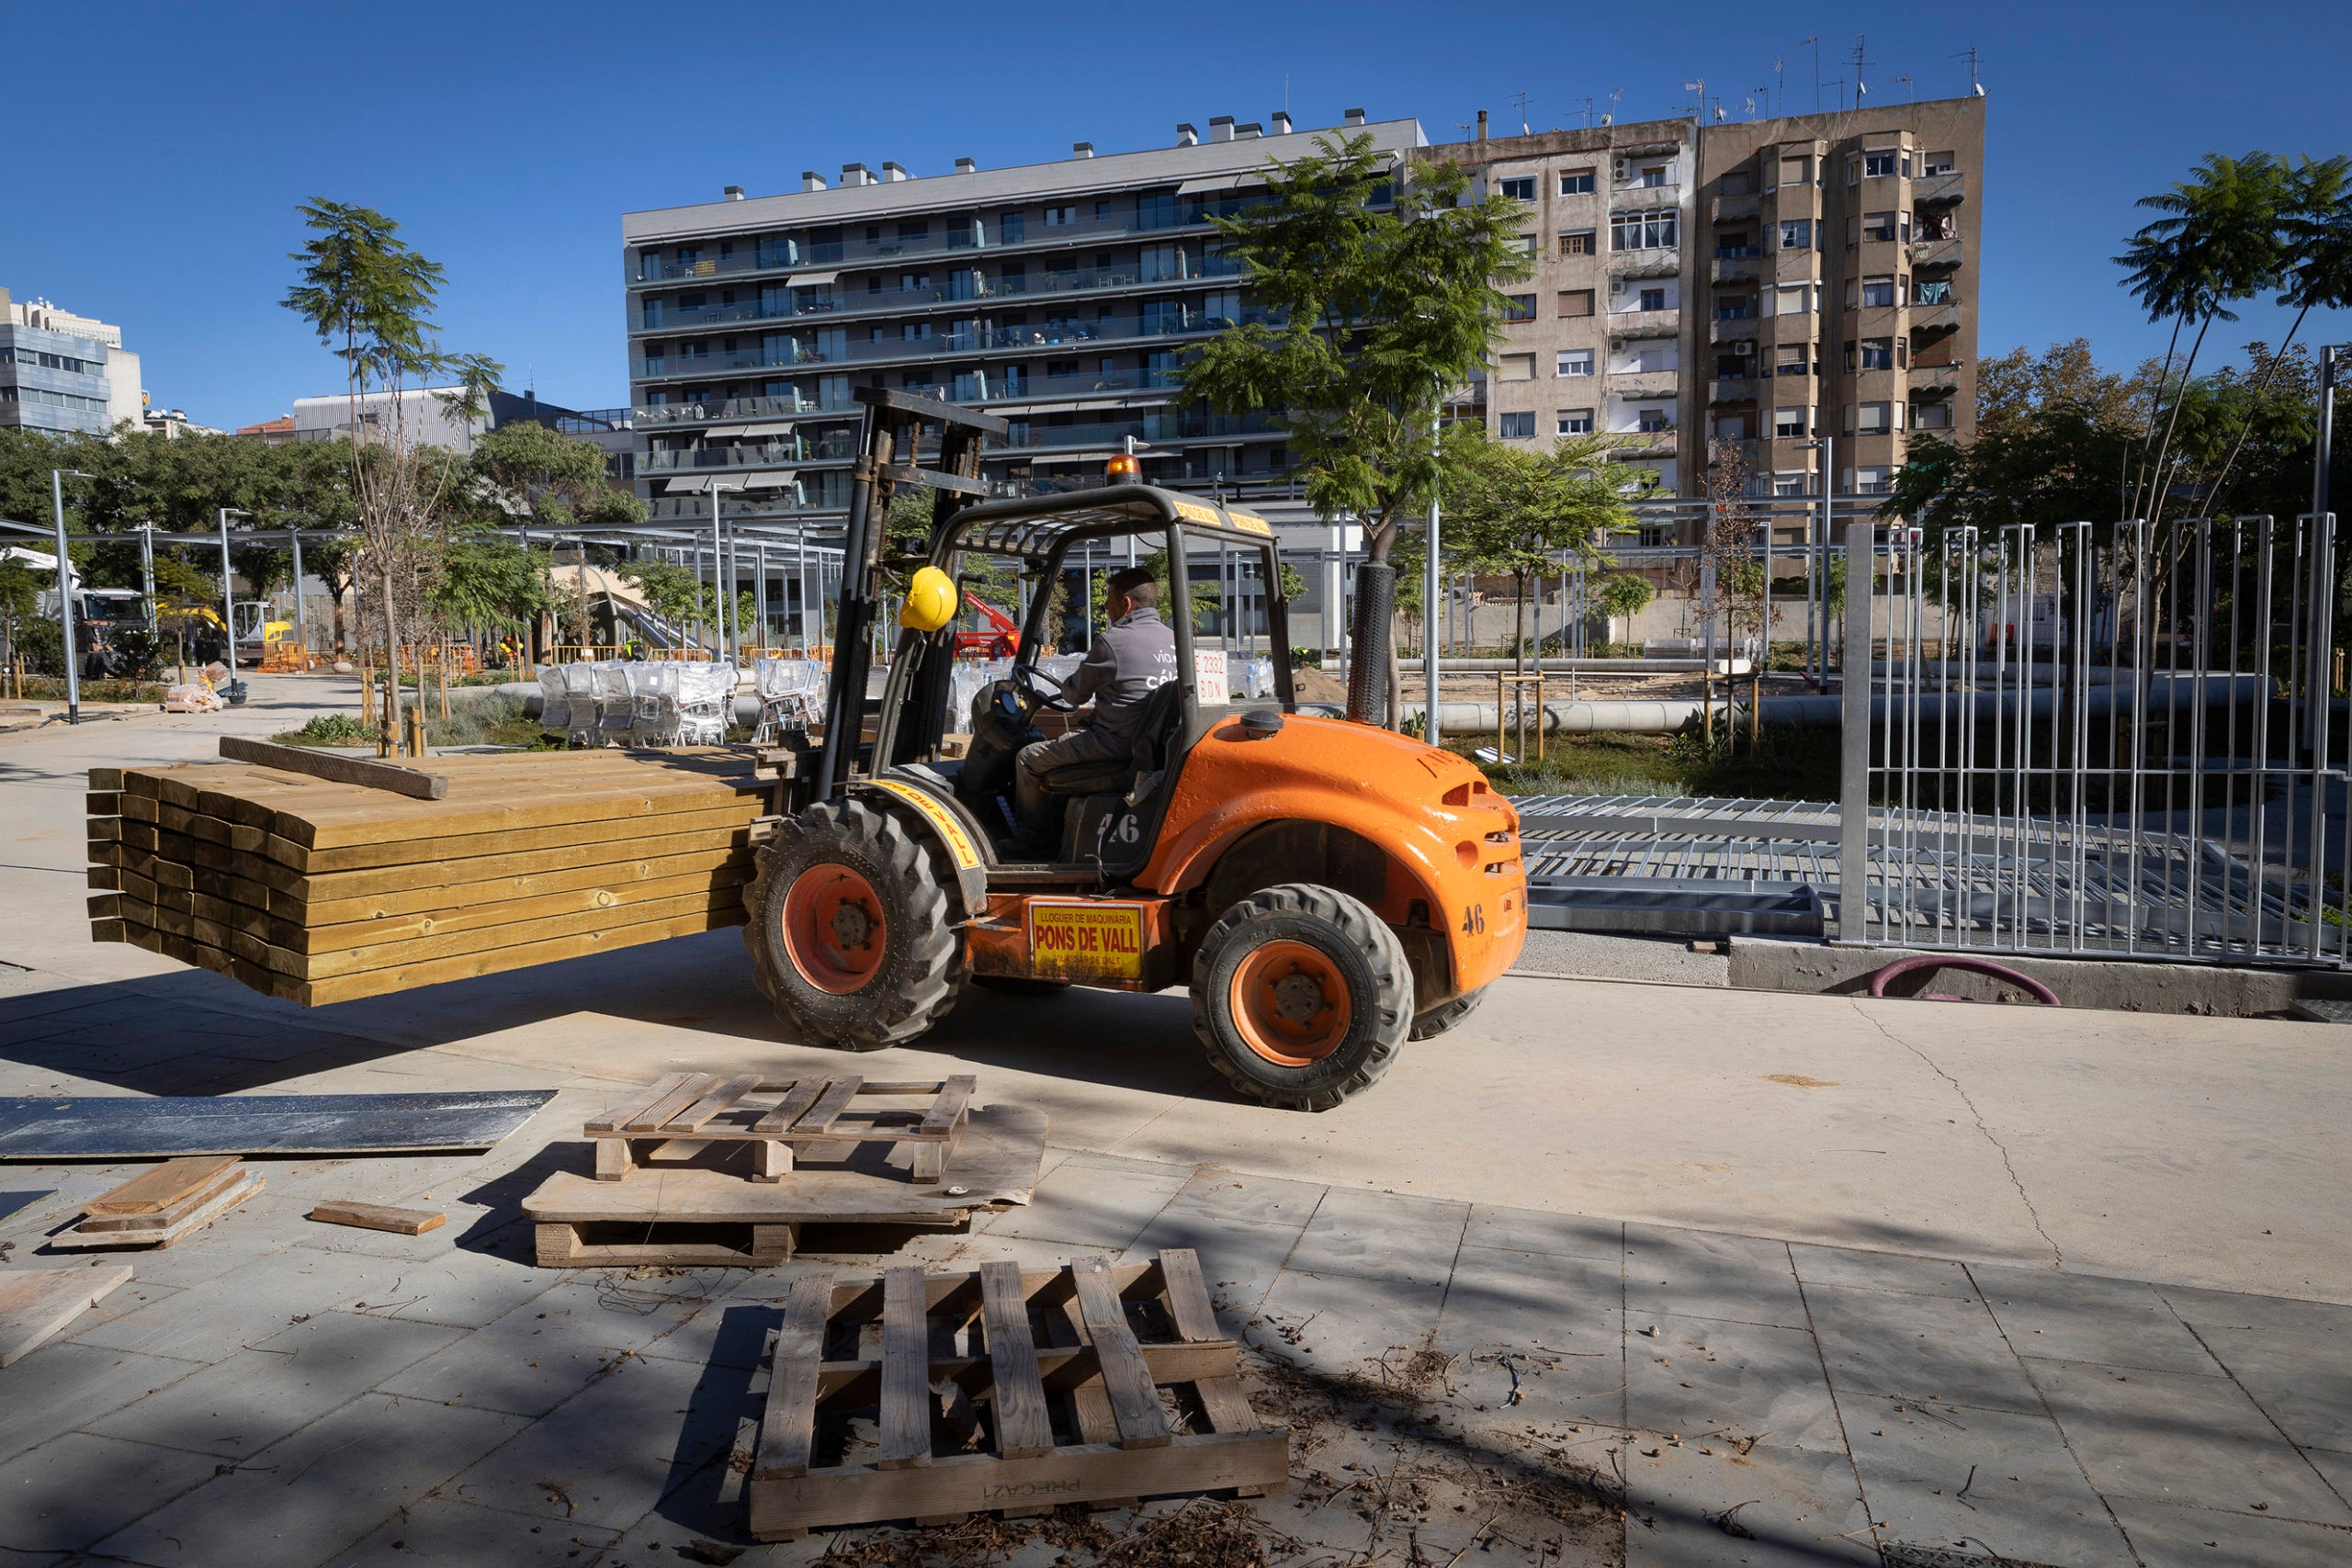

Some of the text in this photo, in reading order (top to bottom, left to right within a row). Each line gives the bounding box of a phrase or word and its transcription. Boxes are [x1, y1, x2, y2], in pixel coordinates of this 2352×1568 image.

[1204, 655, 1224, 674] 2332
[1201, 680, 1221, 698] BDN
[1041, 913, 1074, 923] LLOGUER
[1075, 914, 1085, 924] DE
[1462, 904, 1485, 937] 46
[1035, 925, 1138, 953] PONS DE VALL
[1055, 955, 1120, 965] VILASSAR DE DALT
[983, 1478, 1080, 1498] PRECA21
